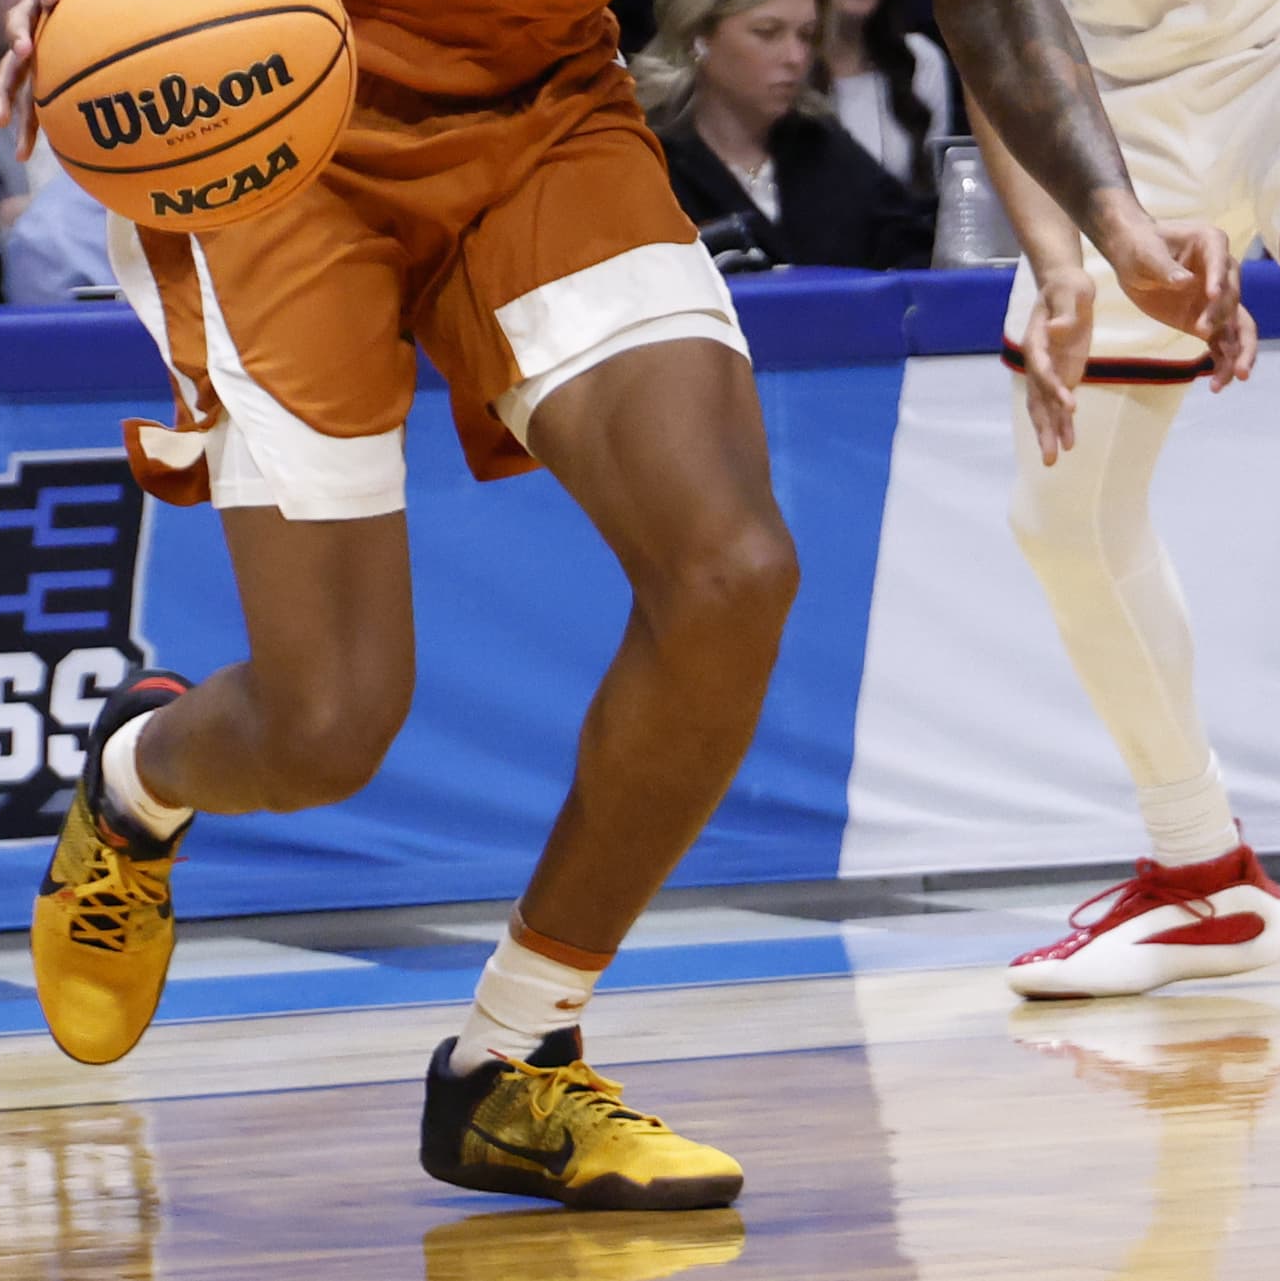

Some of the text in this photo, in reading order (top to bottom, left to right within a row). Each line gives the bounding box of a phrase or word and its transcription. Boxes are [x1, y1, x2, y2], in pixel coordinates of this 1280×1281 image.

[77, 53, 294, 150] Wilson
[199, 118, 230, 135] NXT
[150, 142, 300, 216] NCAA
